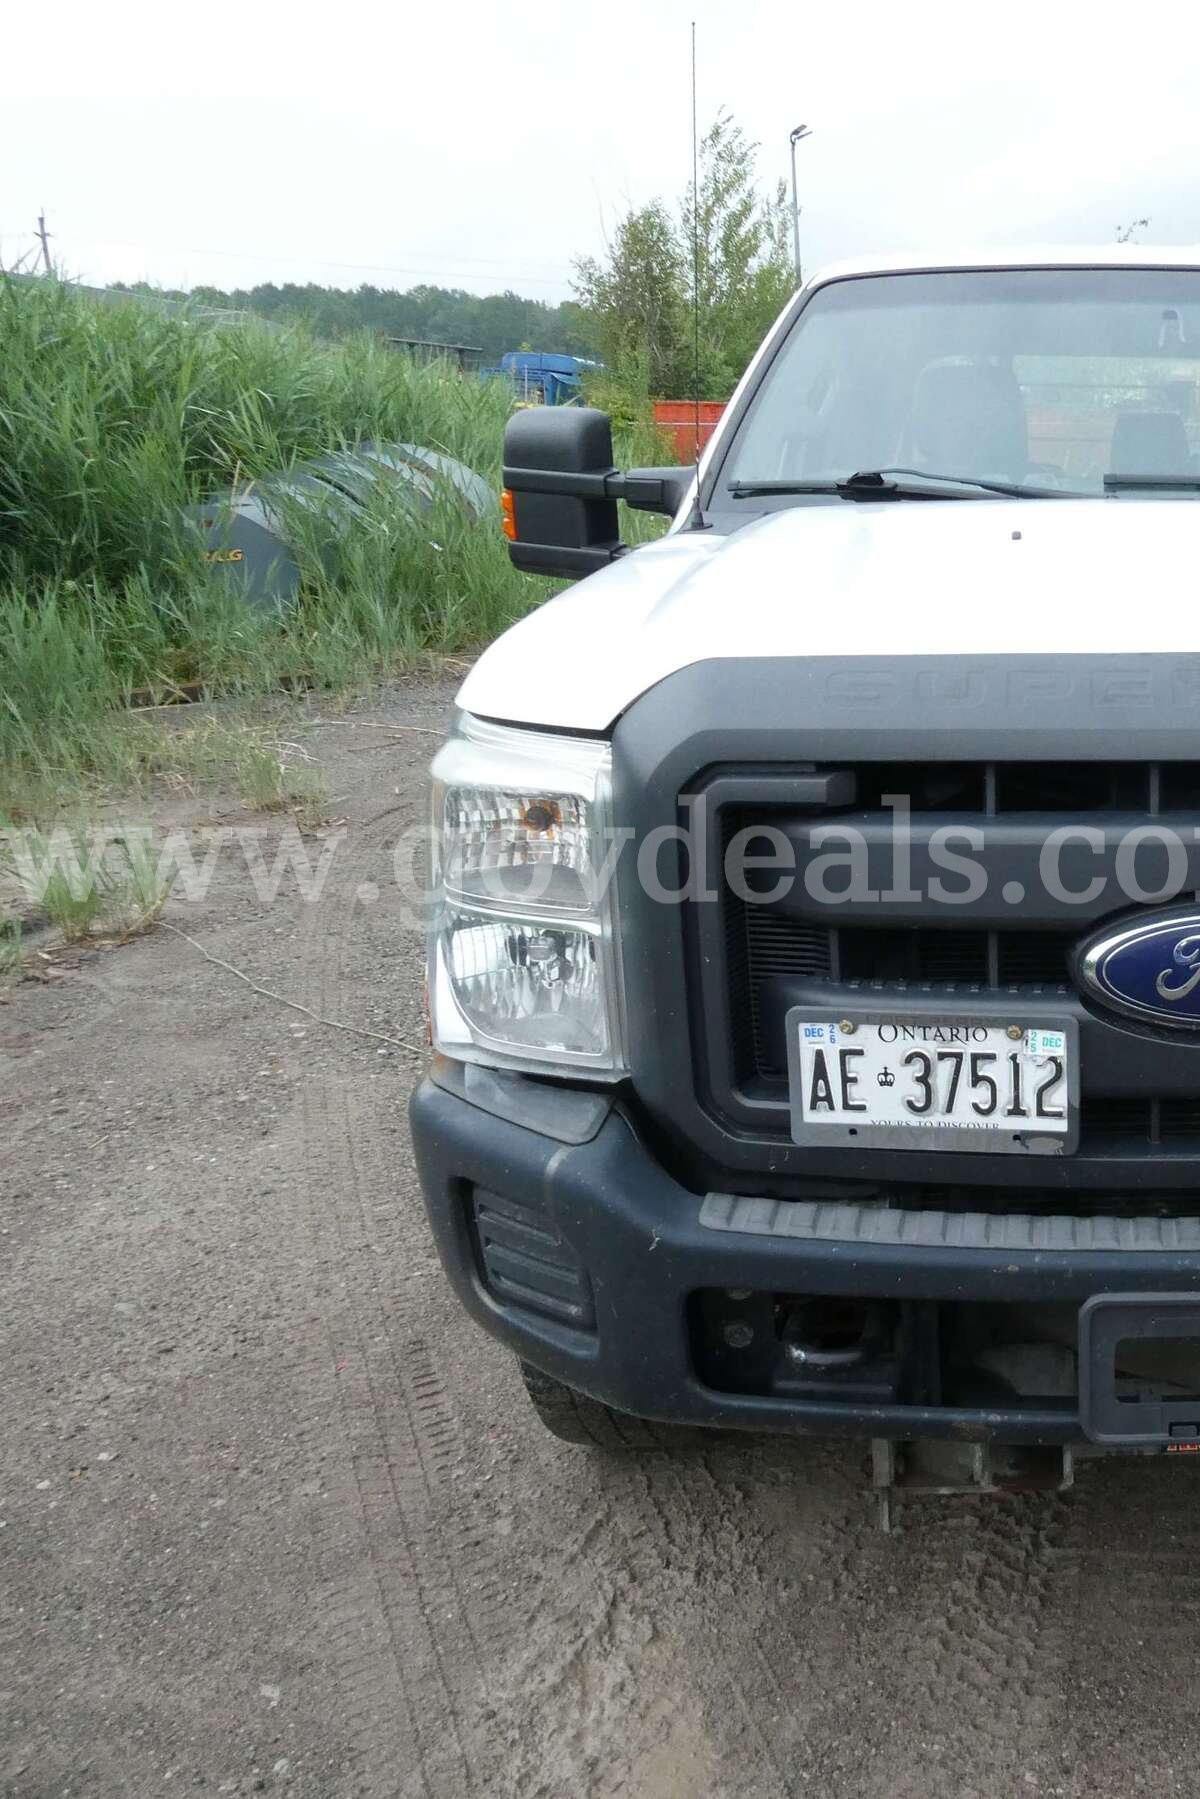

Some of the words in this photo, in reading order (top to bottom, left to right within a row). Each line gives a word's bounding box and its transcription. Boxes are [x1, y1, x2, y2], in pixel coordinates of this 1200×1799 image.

[804, 1027, 824, 1038] DEC
[878, 1023, 988, 1045] ONTARIO
[1042, 1036, 1062, 1047] DEC
[809, 1048, 867, 1111] AE
[904, 1050, 1064, 1118] 37512
